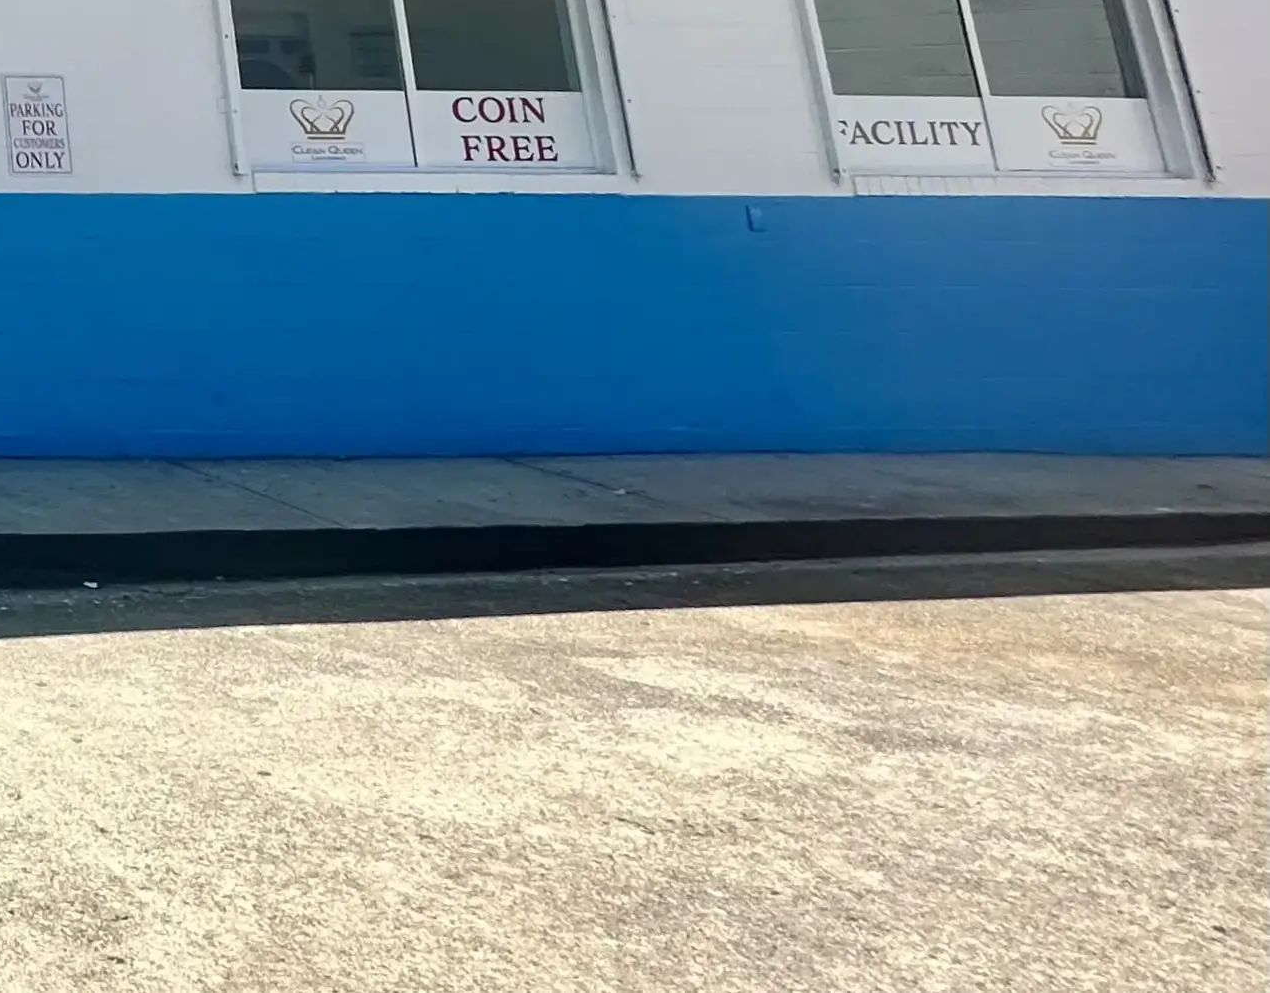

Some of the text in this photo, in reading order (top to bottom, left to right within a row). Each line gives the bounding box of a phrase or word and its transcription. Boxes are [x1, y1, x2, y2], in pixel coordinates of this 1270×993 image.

[9, 102, 64, 118] PARKING
[451, 96, 546, 124] COIN
[21, 119, 58, 136] FOR
[460, 135, 559, 162] FREE
[15, 151, 66, 169] ONLY
